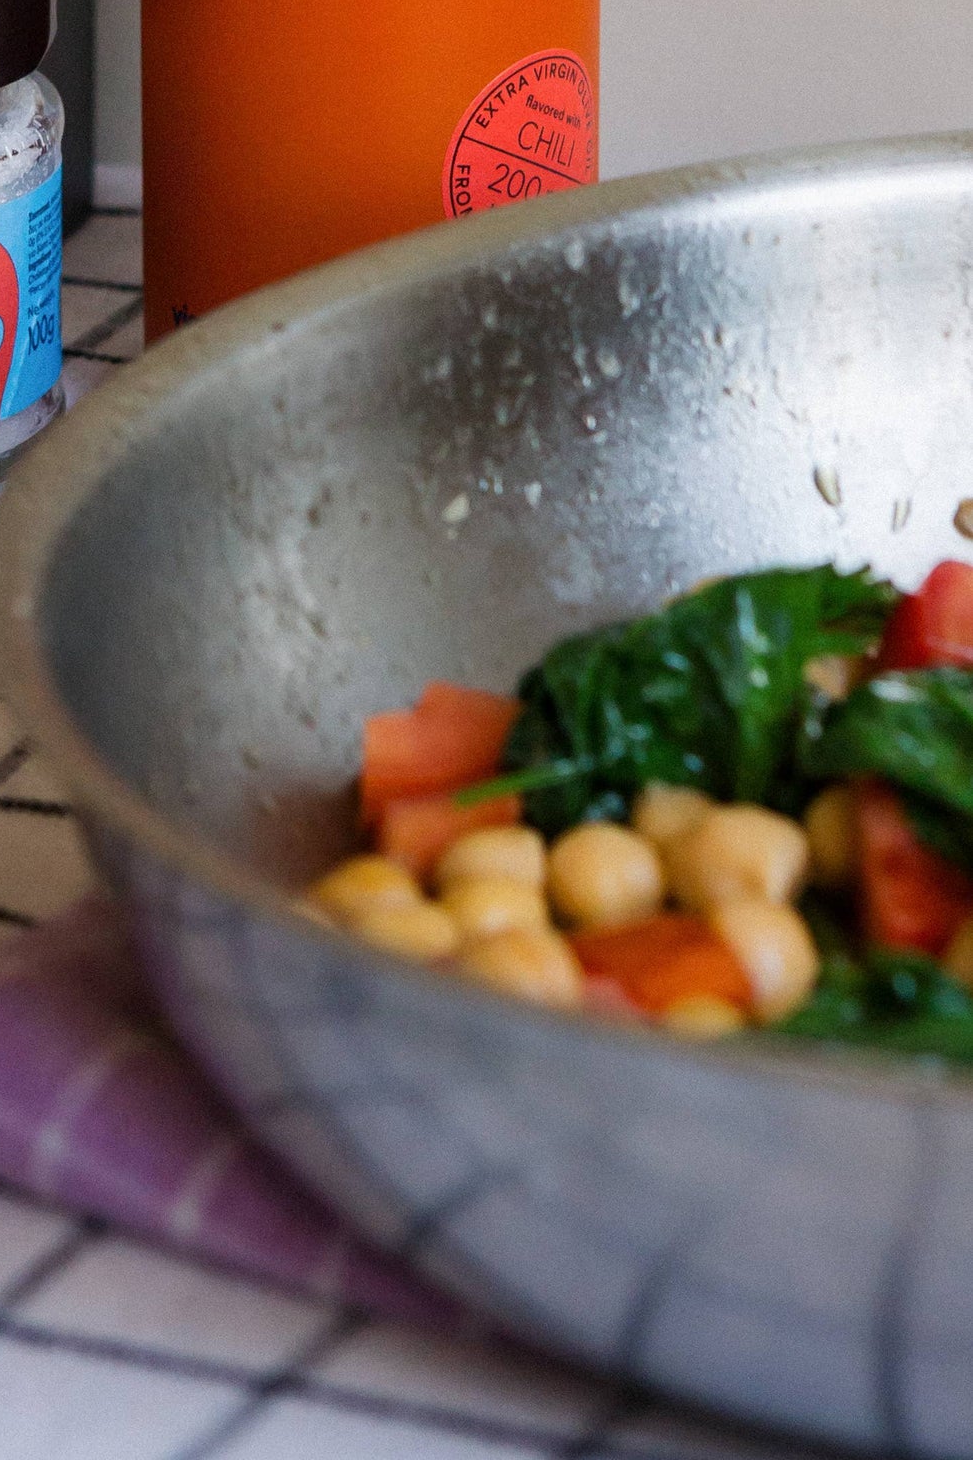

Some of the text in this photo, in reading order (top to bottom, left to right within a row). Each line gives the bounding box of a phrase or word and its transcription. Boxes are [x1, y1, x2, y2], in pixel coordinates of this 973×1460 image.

[476, 75, 529, 129] EXTRA
[533, 63, 577, 85] VIRGIN
[525, 94, 565, 121] flavored
[518, 121, 575, 167] CHILI
[488, 163, 541, 200] 200
[28, 314, 55, 356] 100g
